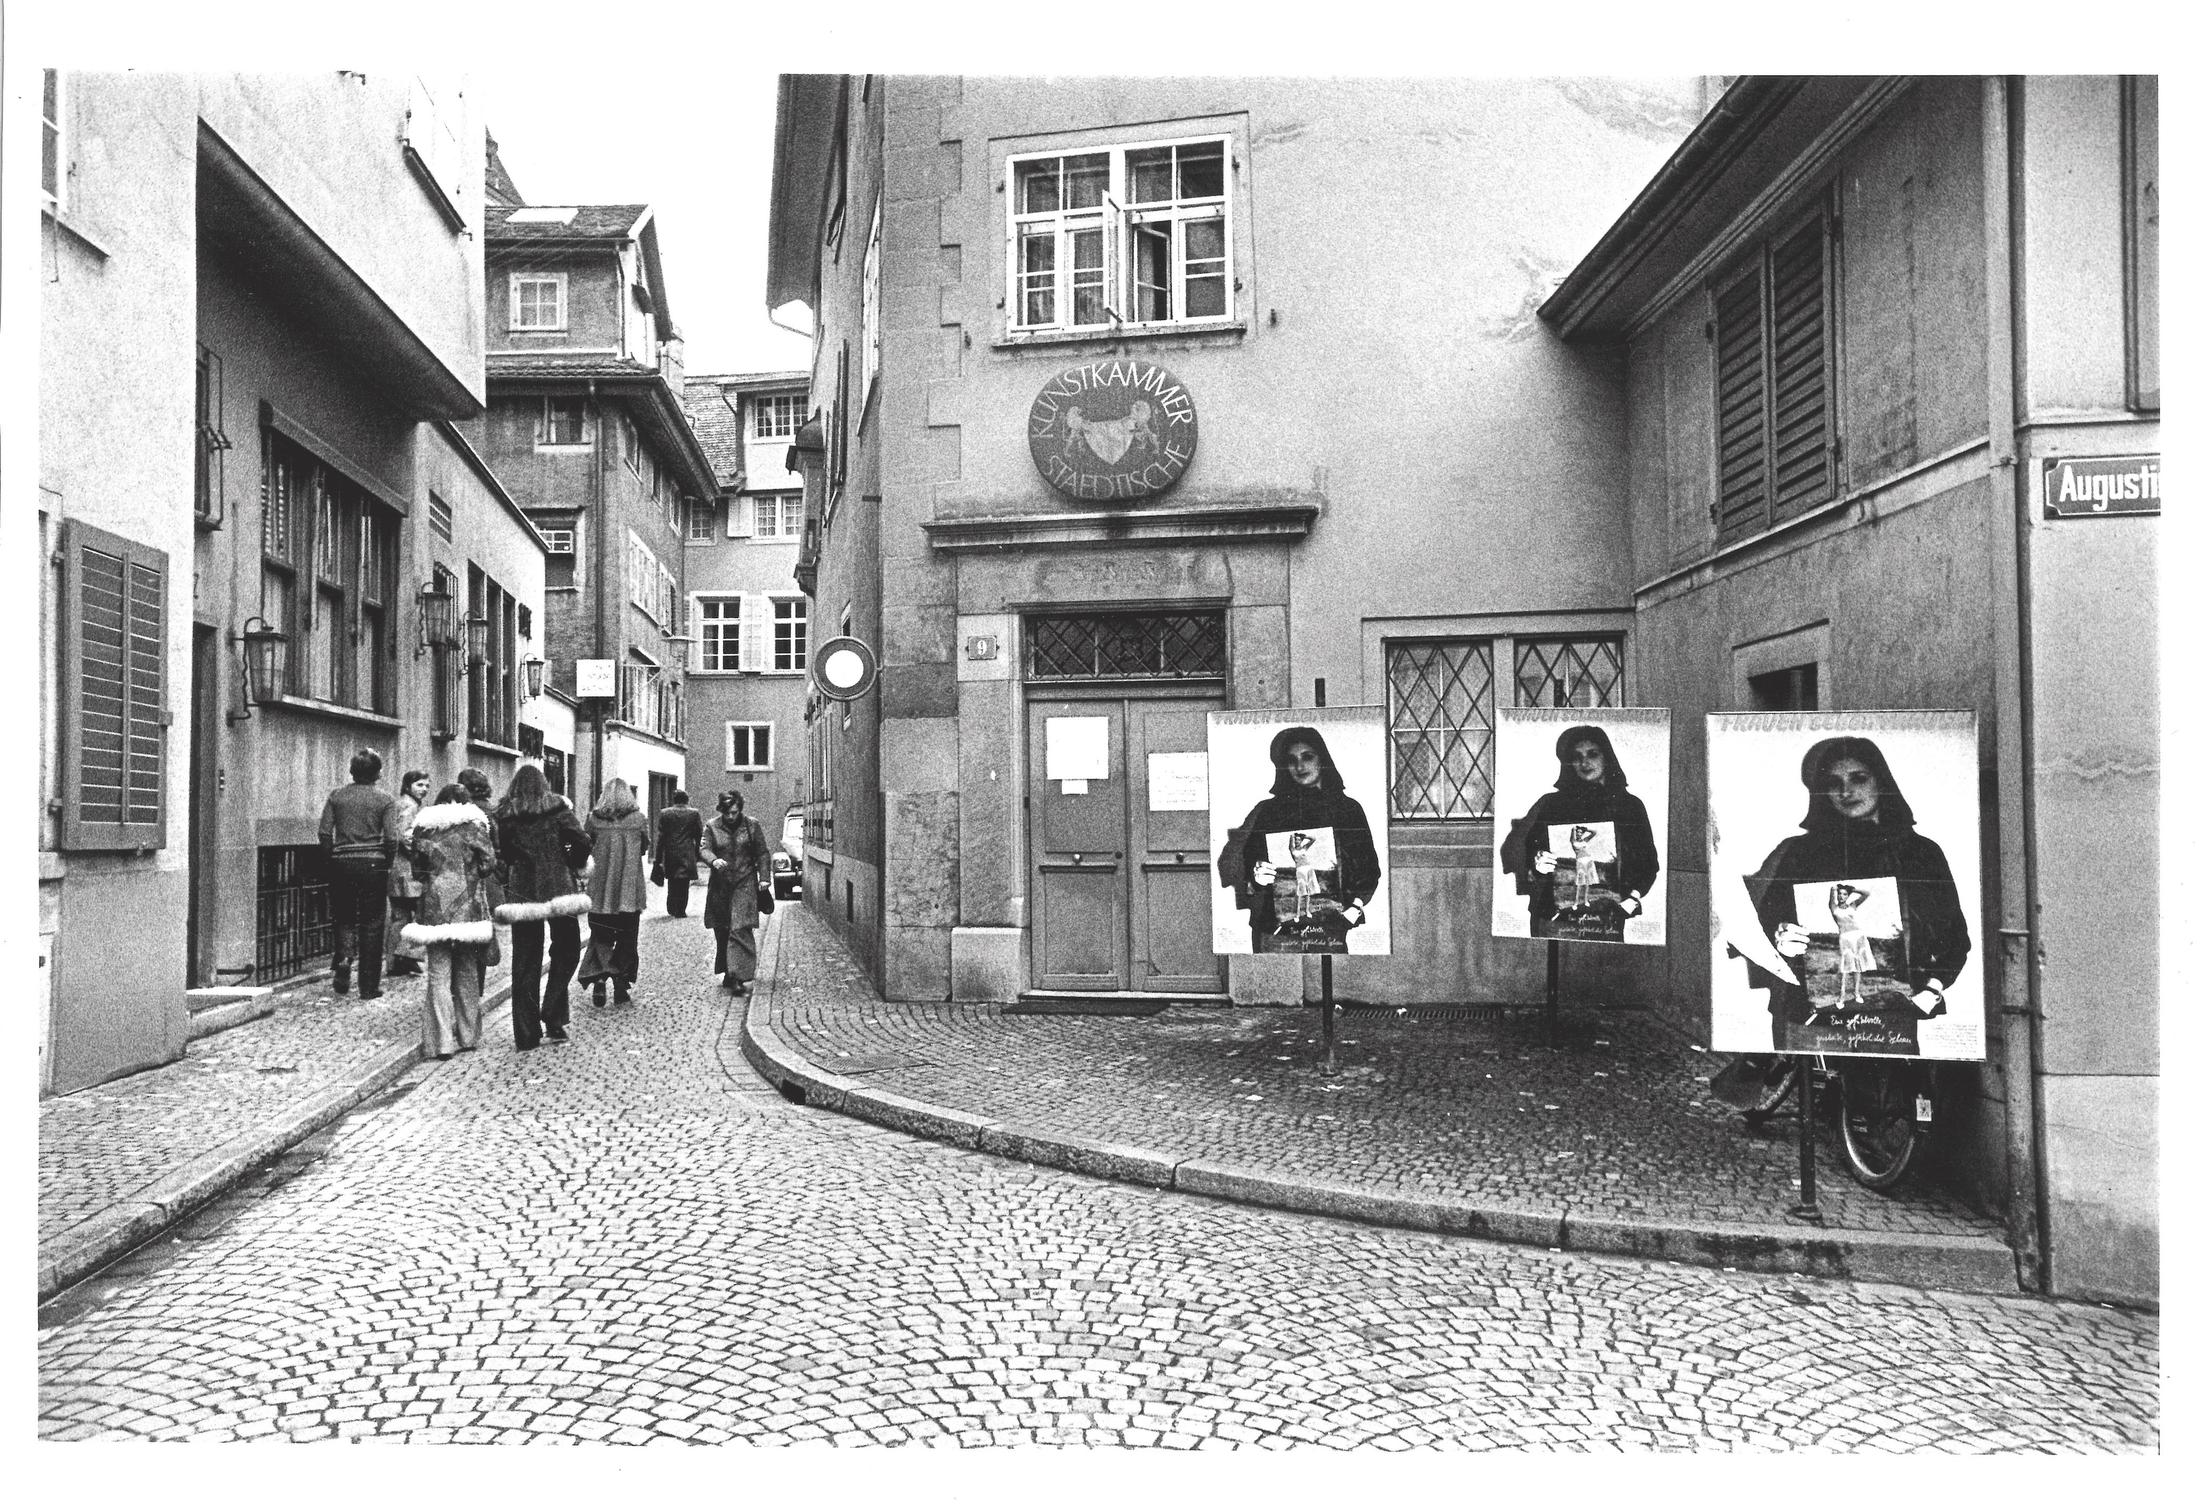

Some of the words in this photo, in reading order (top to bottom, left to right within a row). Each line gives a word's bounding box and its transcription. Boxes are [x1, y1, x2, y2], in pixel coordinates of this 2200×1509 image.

[1031, 361, 1194, 438] KUNSTKAMMER
[1044, 439, 1192, 498] STAEDTISCHE
[2059, 464, 2160, 511] Augusti
[976, 640, 987, 655] 9
[1718, 714, 1803, 731] FRAUEN
